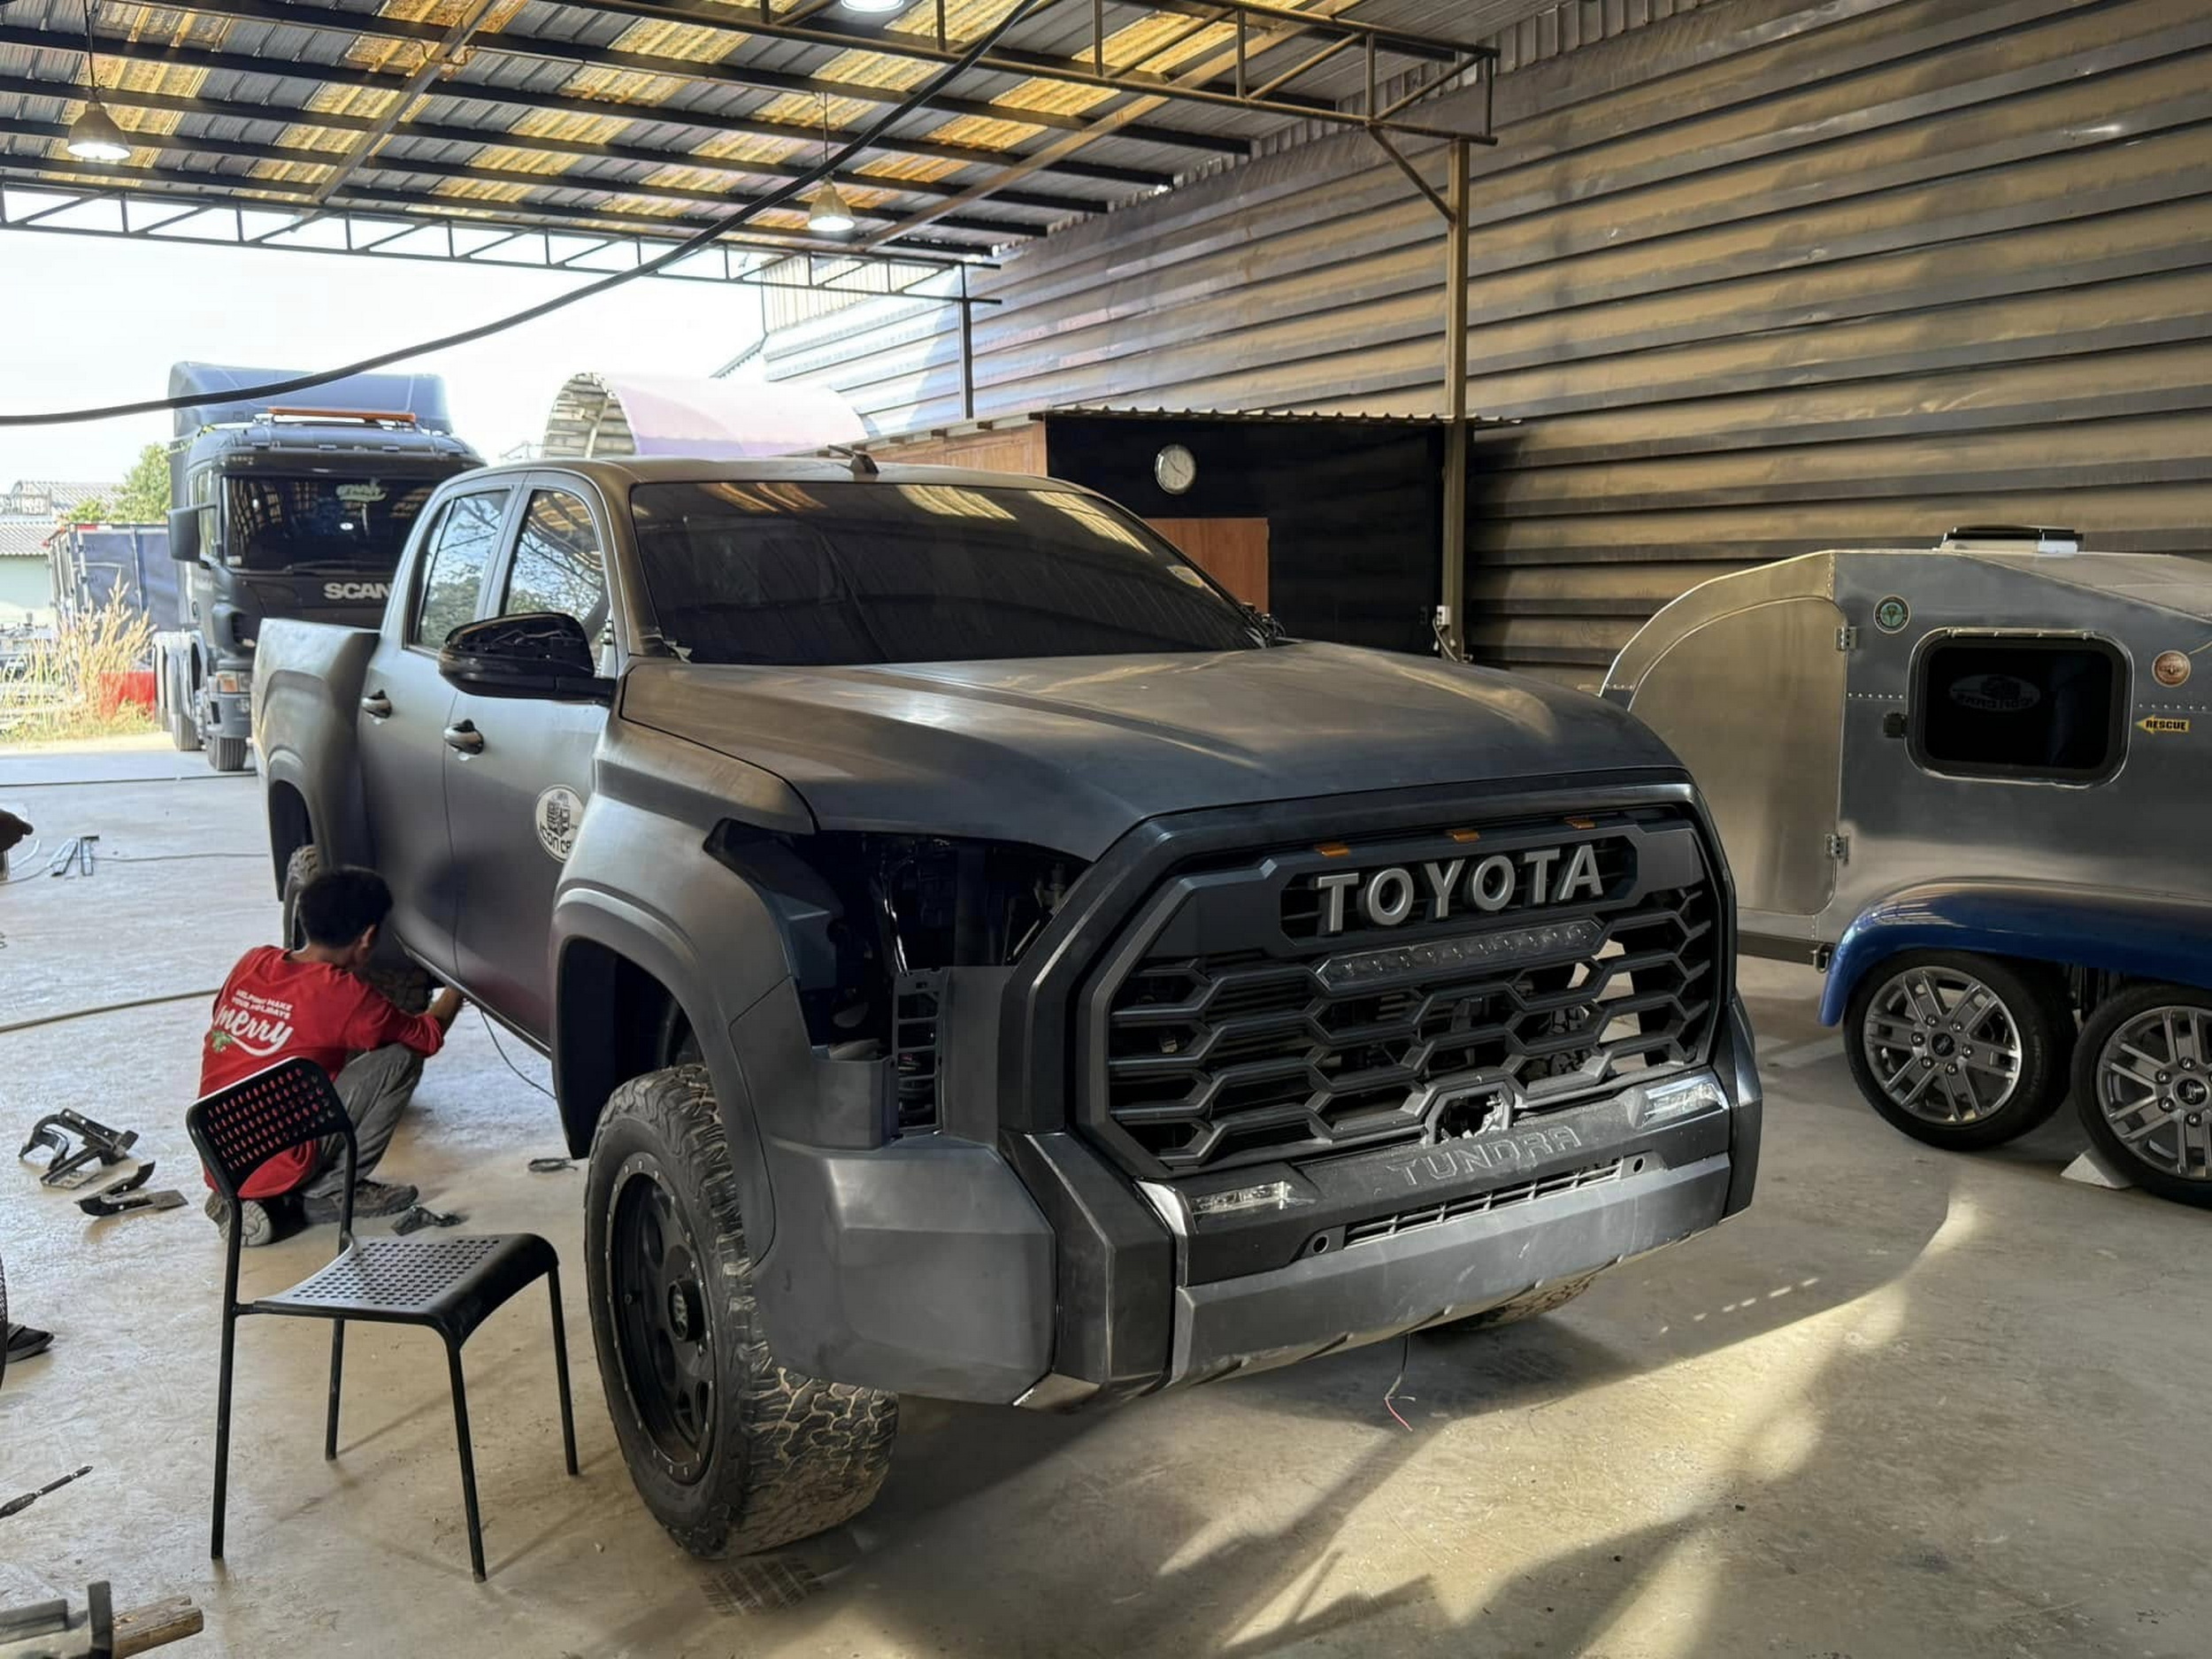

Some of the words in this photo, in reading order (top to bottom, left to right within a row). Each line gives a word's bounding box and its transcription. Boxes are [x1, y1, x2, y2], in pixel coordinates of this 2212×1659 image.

[2146, 720, 2186, 731] RESCUE
[1317, 844, 1603, 932] TOYOTA
[214, 1005, 295, 1056] merry
[1386, 1125, 1582, 1186] TUNDRA
